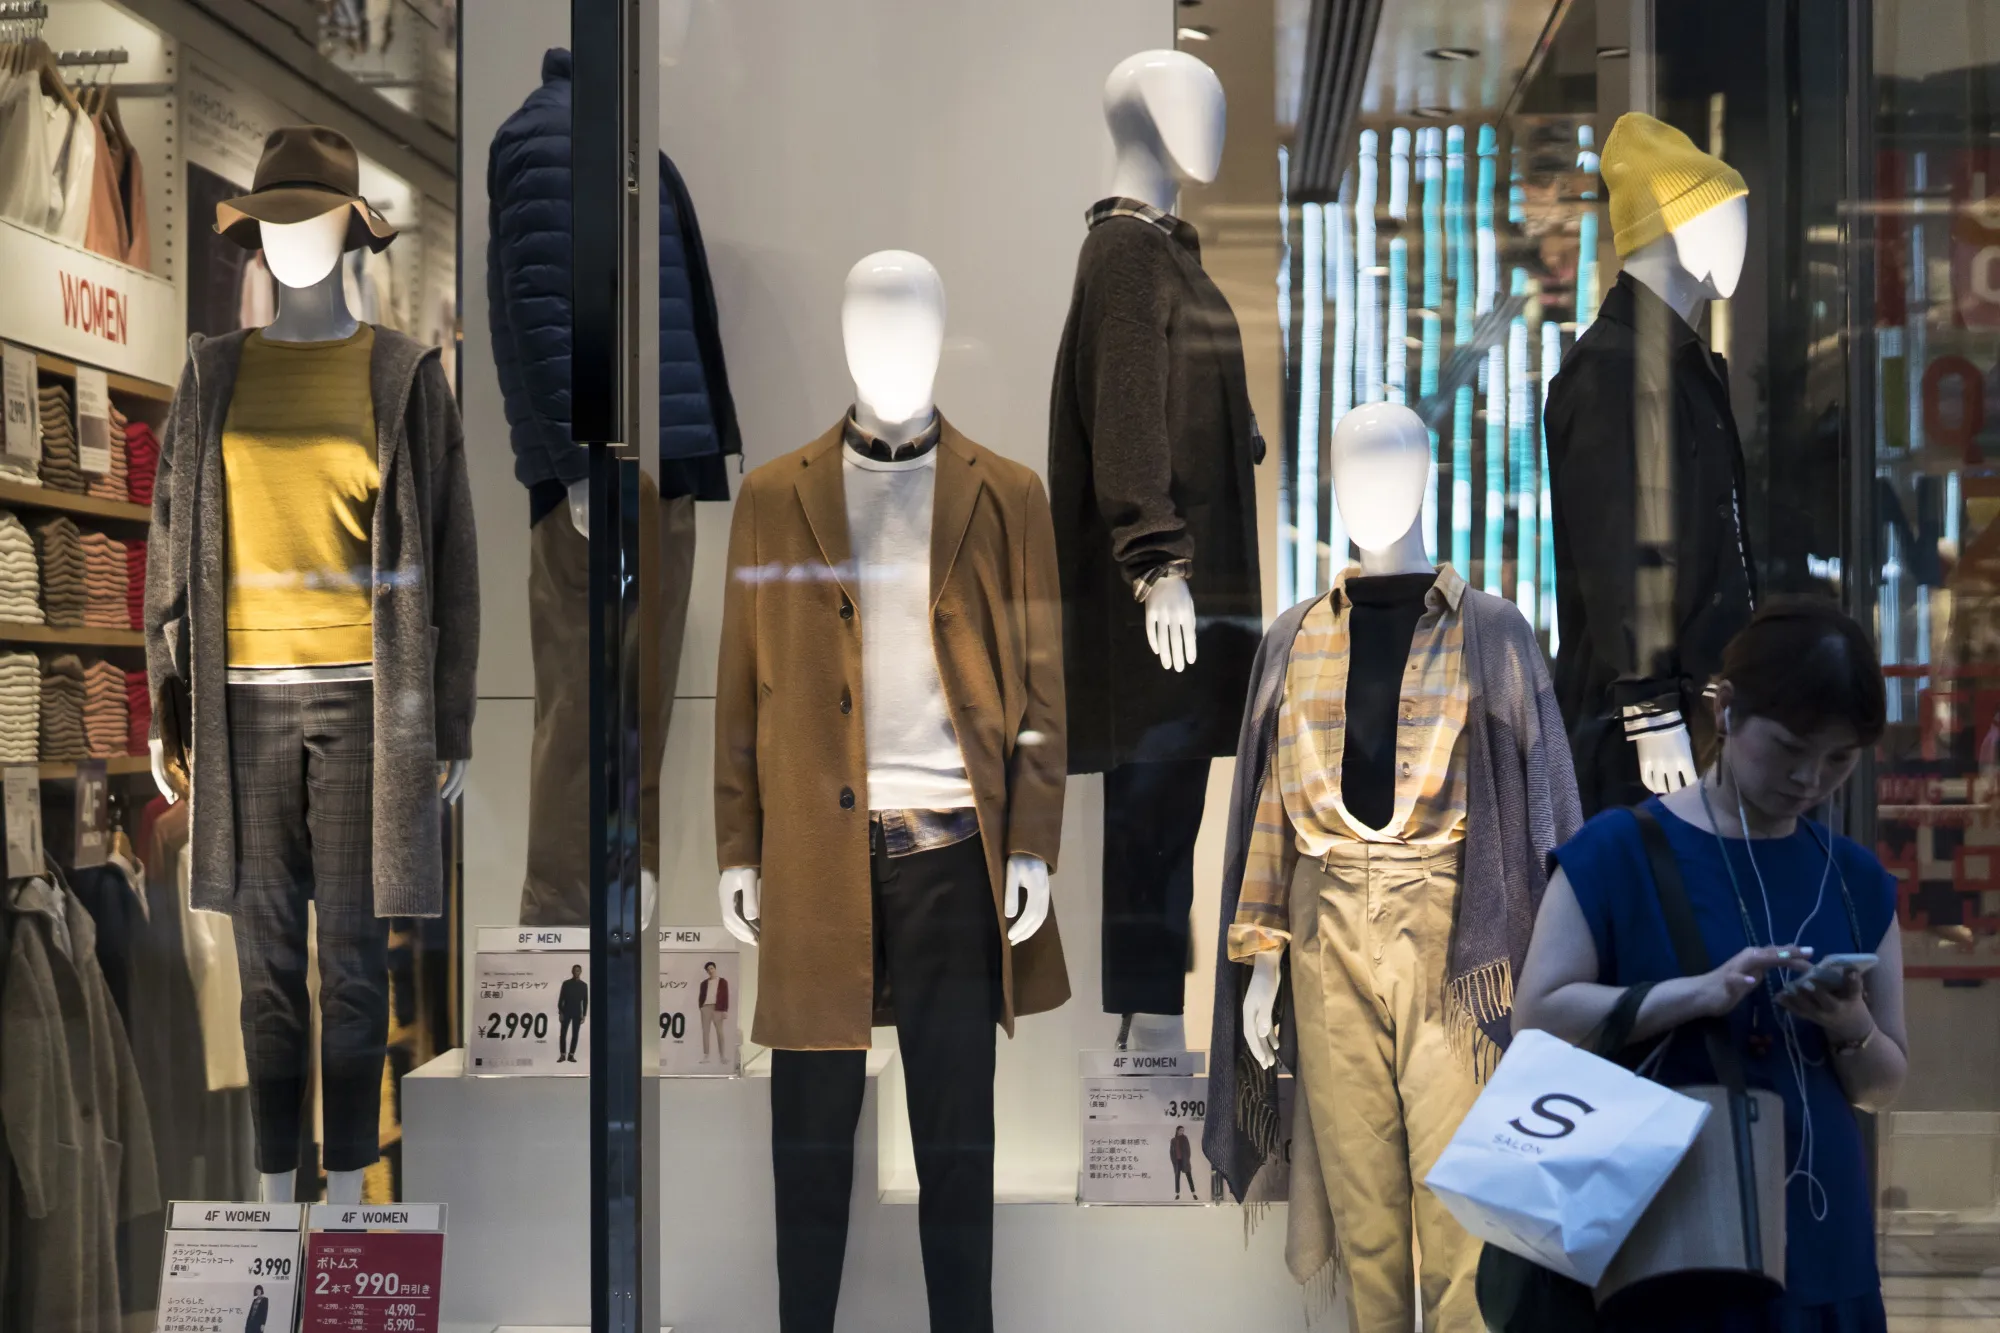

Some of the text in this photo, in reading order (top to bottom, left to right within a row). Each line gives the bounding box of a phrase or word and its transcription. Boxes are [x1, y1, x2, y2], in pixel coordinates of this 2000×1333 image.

[59, 270, 128, 345] WOMEN
[518, 933, 562, 943] 8F MEN
[676, 931, 700, 942] MEN
[480, 981, 548, 990] コーデュロイシャツ
[478, 1012, 548, 1040] ¥2,990
[1113, 1057, 1177, 1068] 4F WOMEN
[1164, 1100, 1205, 1118] ¥3,990
[1507, 1092, 1597, 1139] S
[1492, 1133, 1544, 1155] SALON
[204, 1210, 271, 1223] 4F WOMEN
[341, 1211, 409, 1224] 4F WOMEN
[172, 1249, 214, 1257] メランジウール
[248, 1257, 291, 1276] ¥3,990
[316, 1257, 359, 1269] ボトムス
